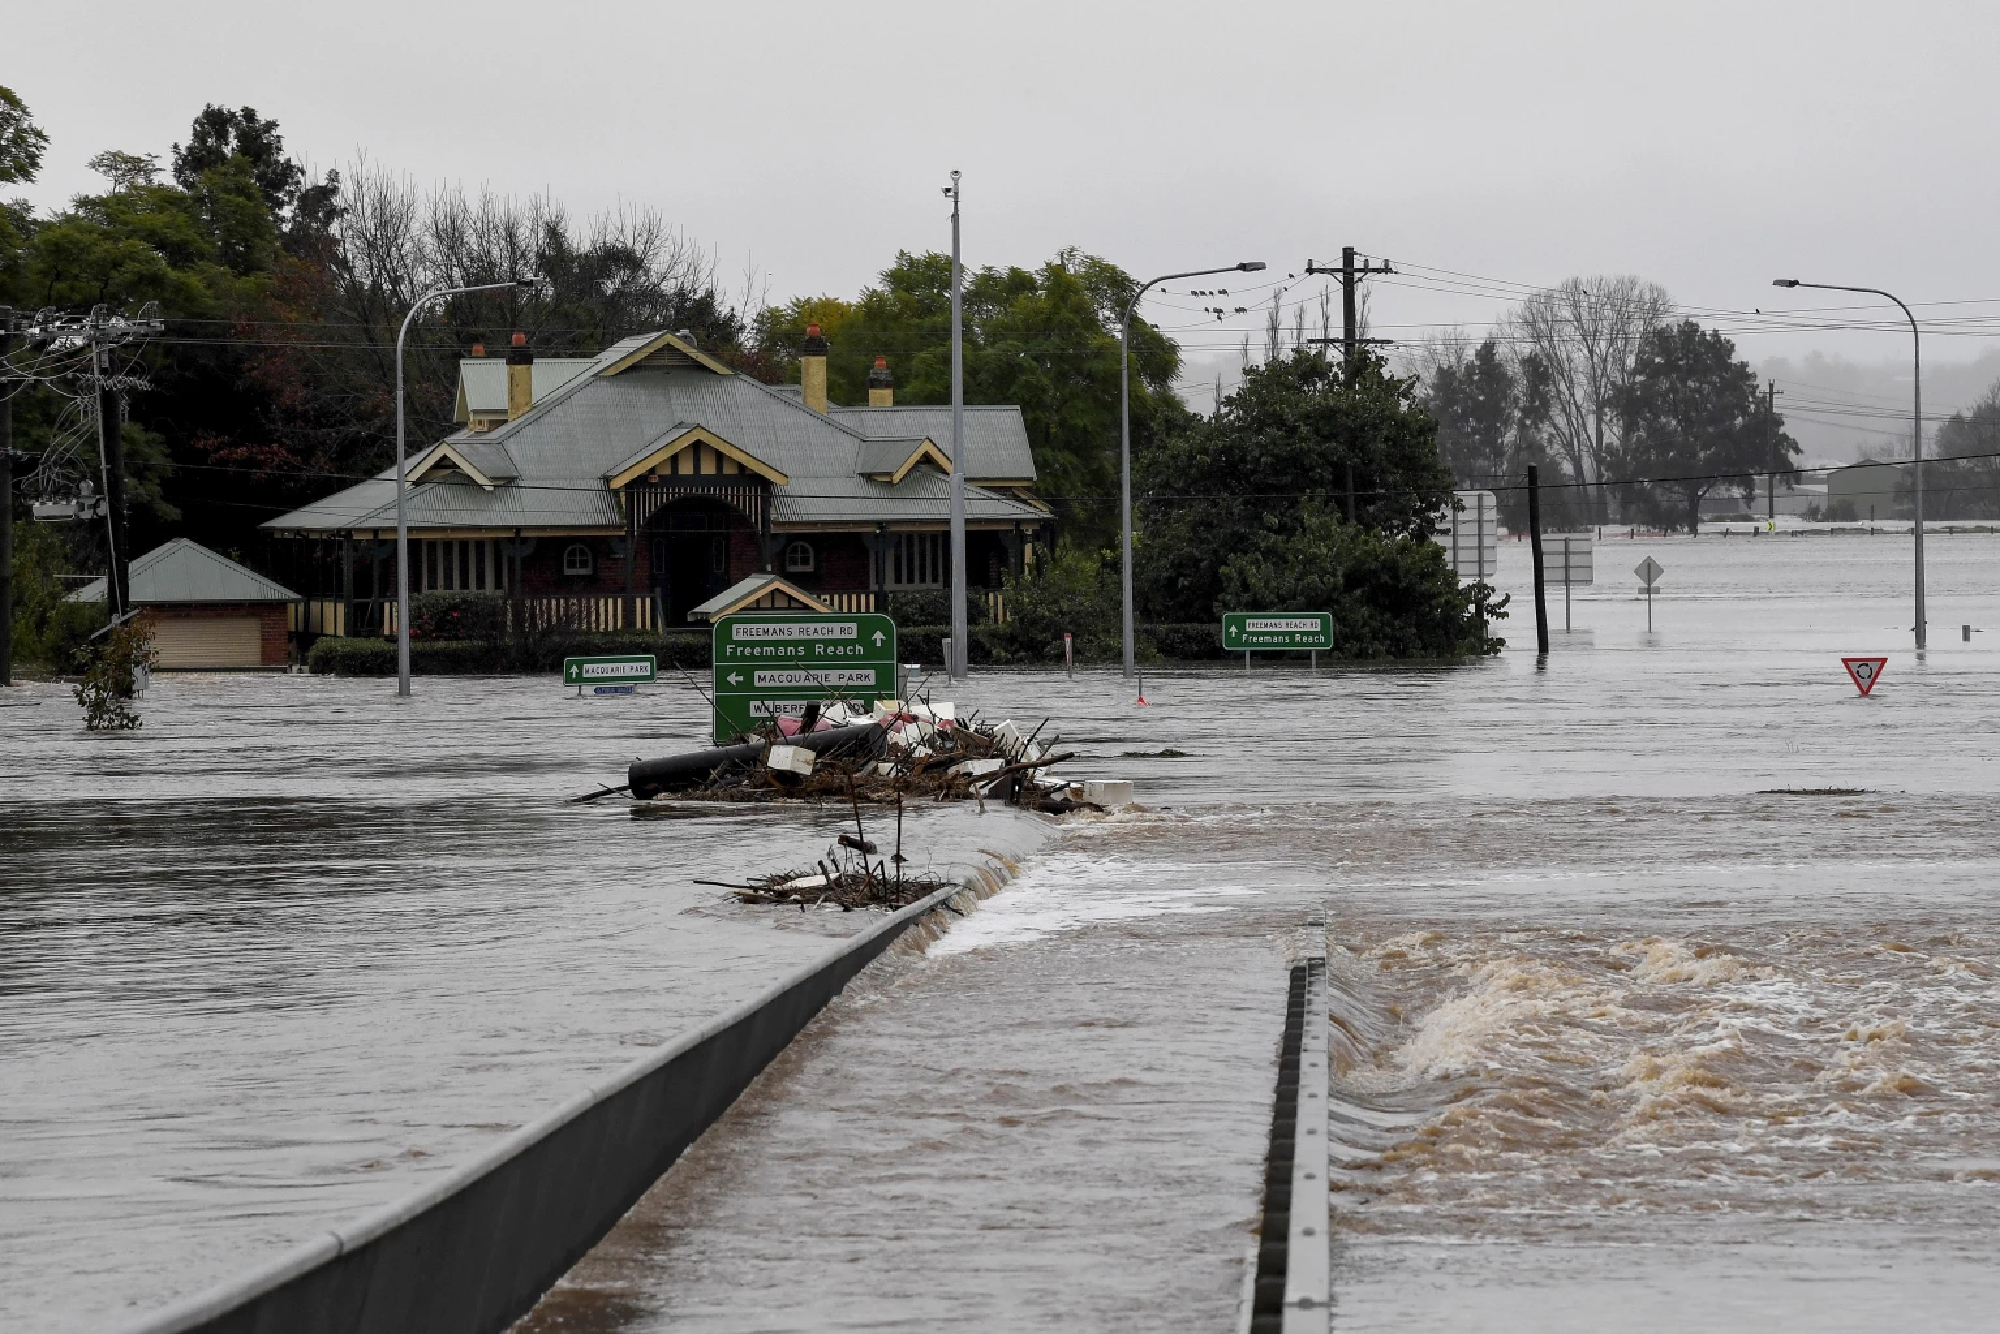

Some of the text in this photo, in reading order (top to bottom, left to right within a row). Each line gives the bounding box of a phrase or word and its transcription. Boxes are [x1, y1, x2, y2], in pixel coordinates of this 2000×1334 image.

[1247, 621, 1282, 629] FREEMANS
[735, 626, 854, 637] FREEMANS REACH RD
[1242, 633, 1325, 643] Freemans Reach
[726, 644, 864, 656] Freemans Reach
[757, 673, 871, 684] MACQUARIE PARK
